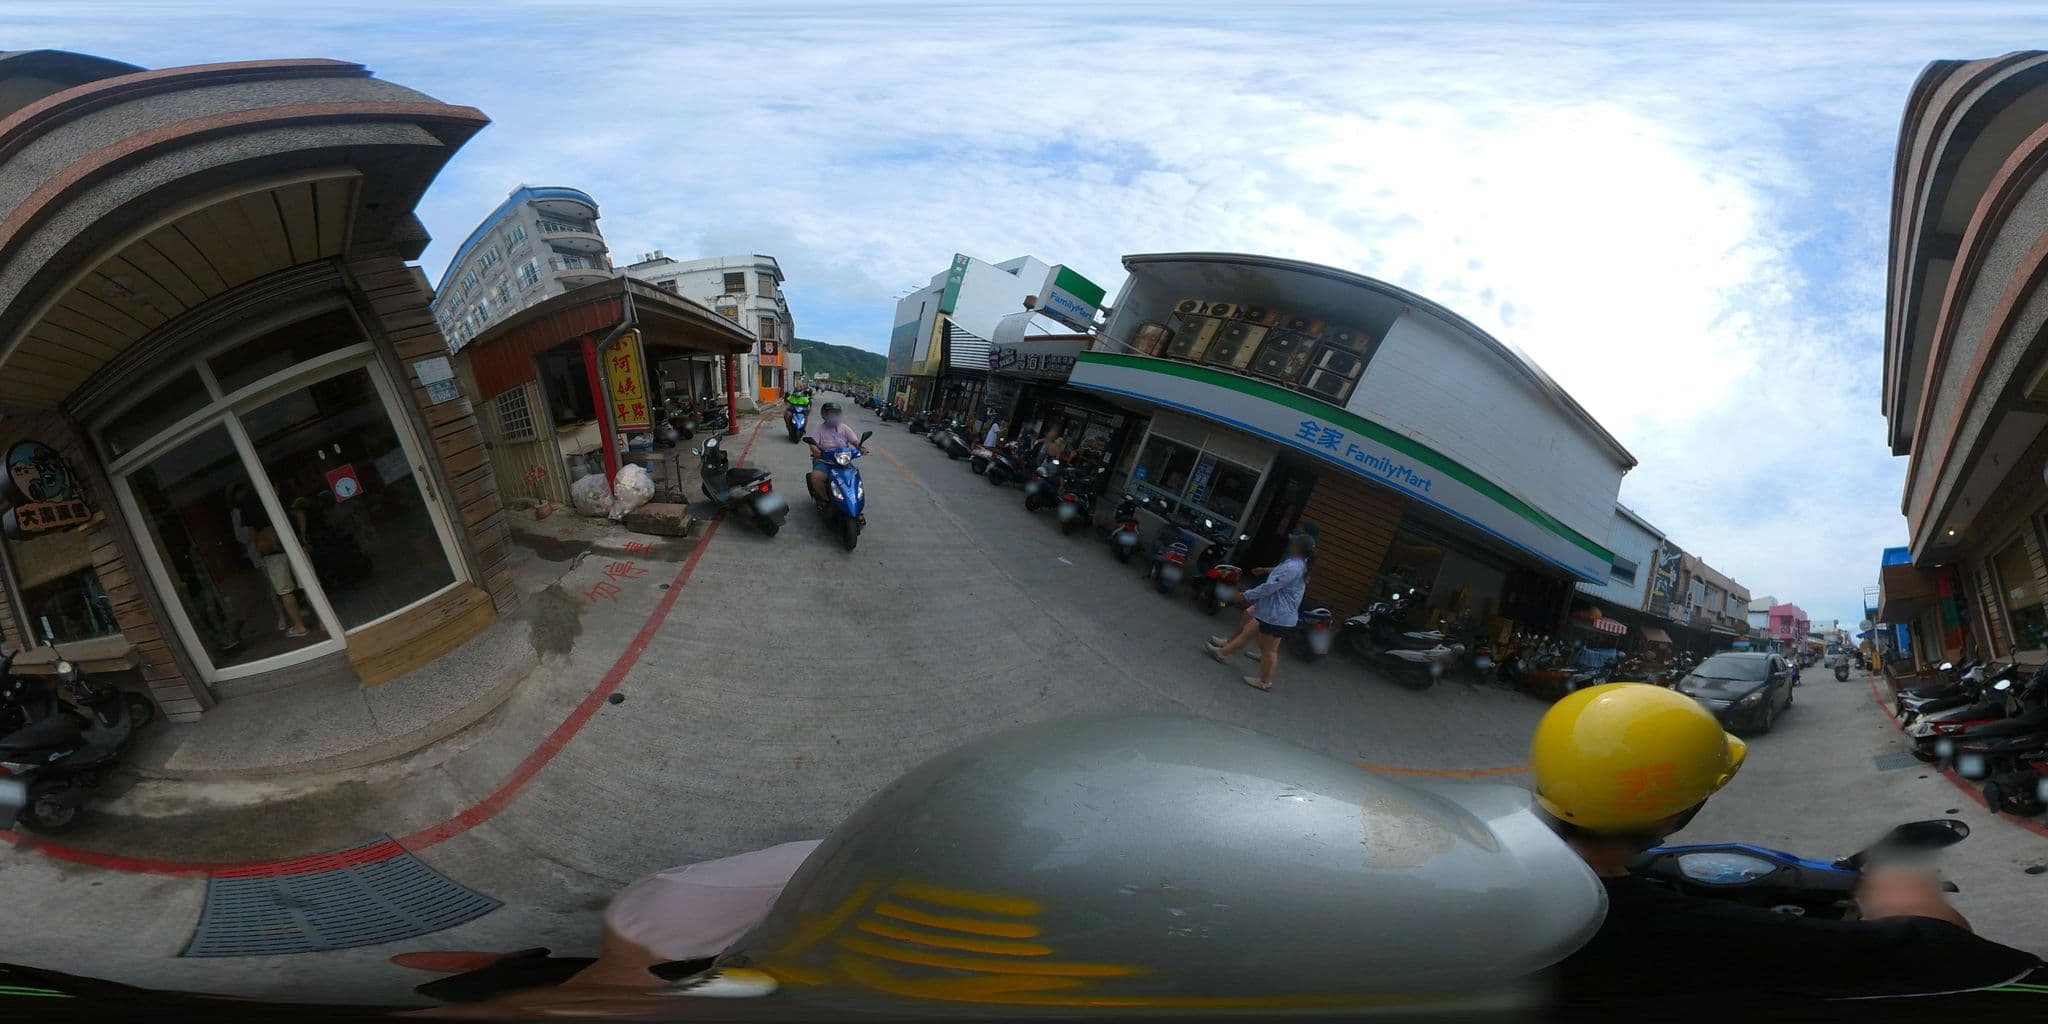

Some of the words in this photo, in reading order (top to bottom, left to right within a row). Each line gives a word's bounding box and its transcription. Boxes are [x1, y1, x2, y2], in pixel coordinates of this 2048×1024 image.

[1049, 290, 1093, 321] FamilyMart
[1295, 420, 1344, 452] 全家
[1345, 443, 1433, 493] FamilyMart
